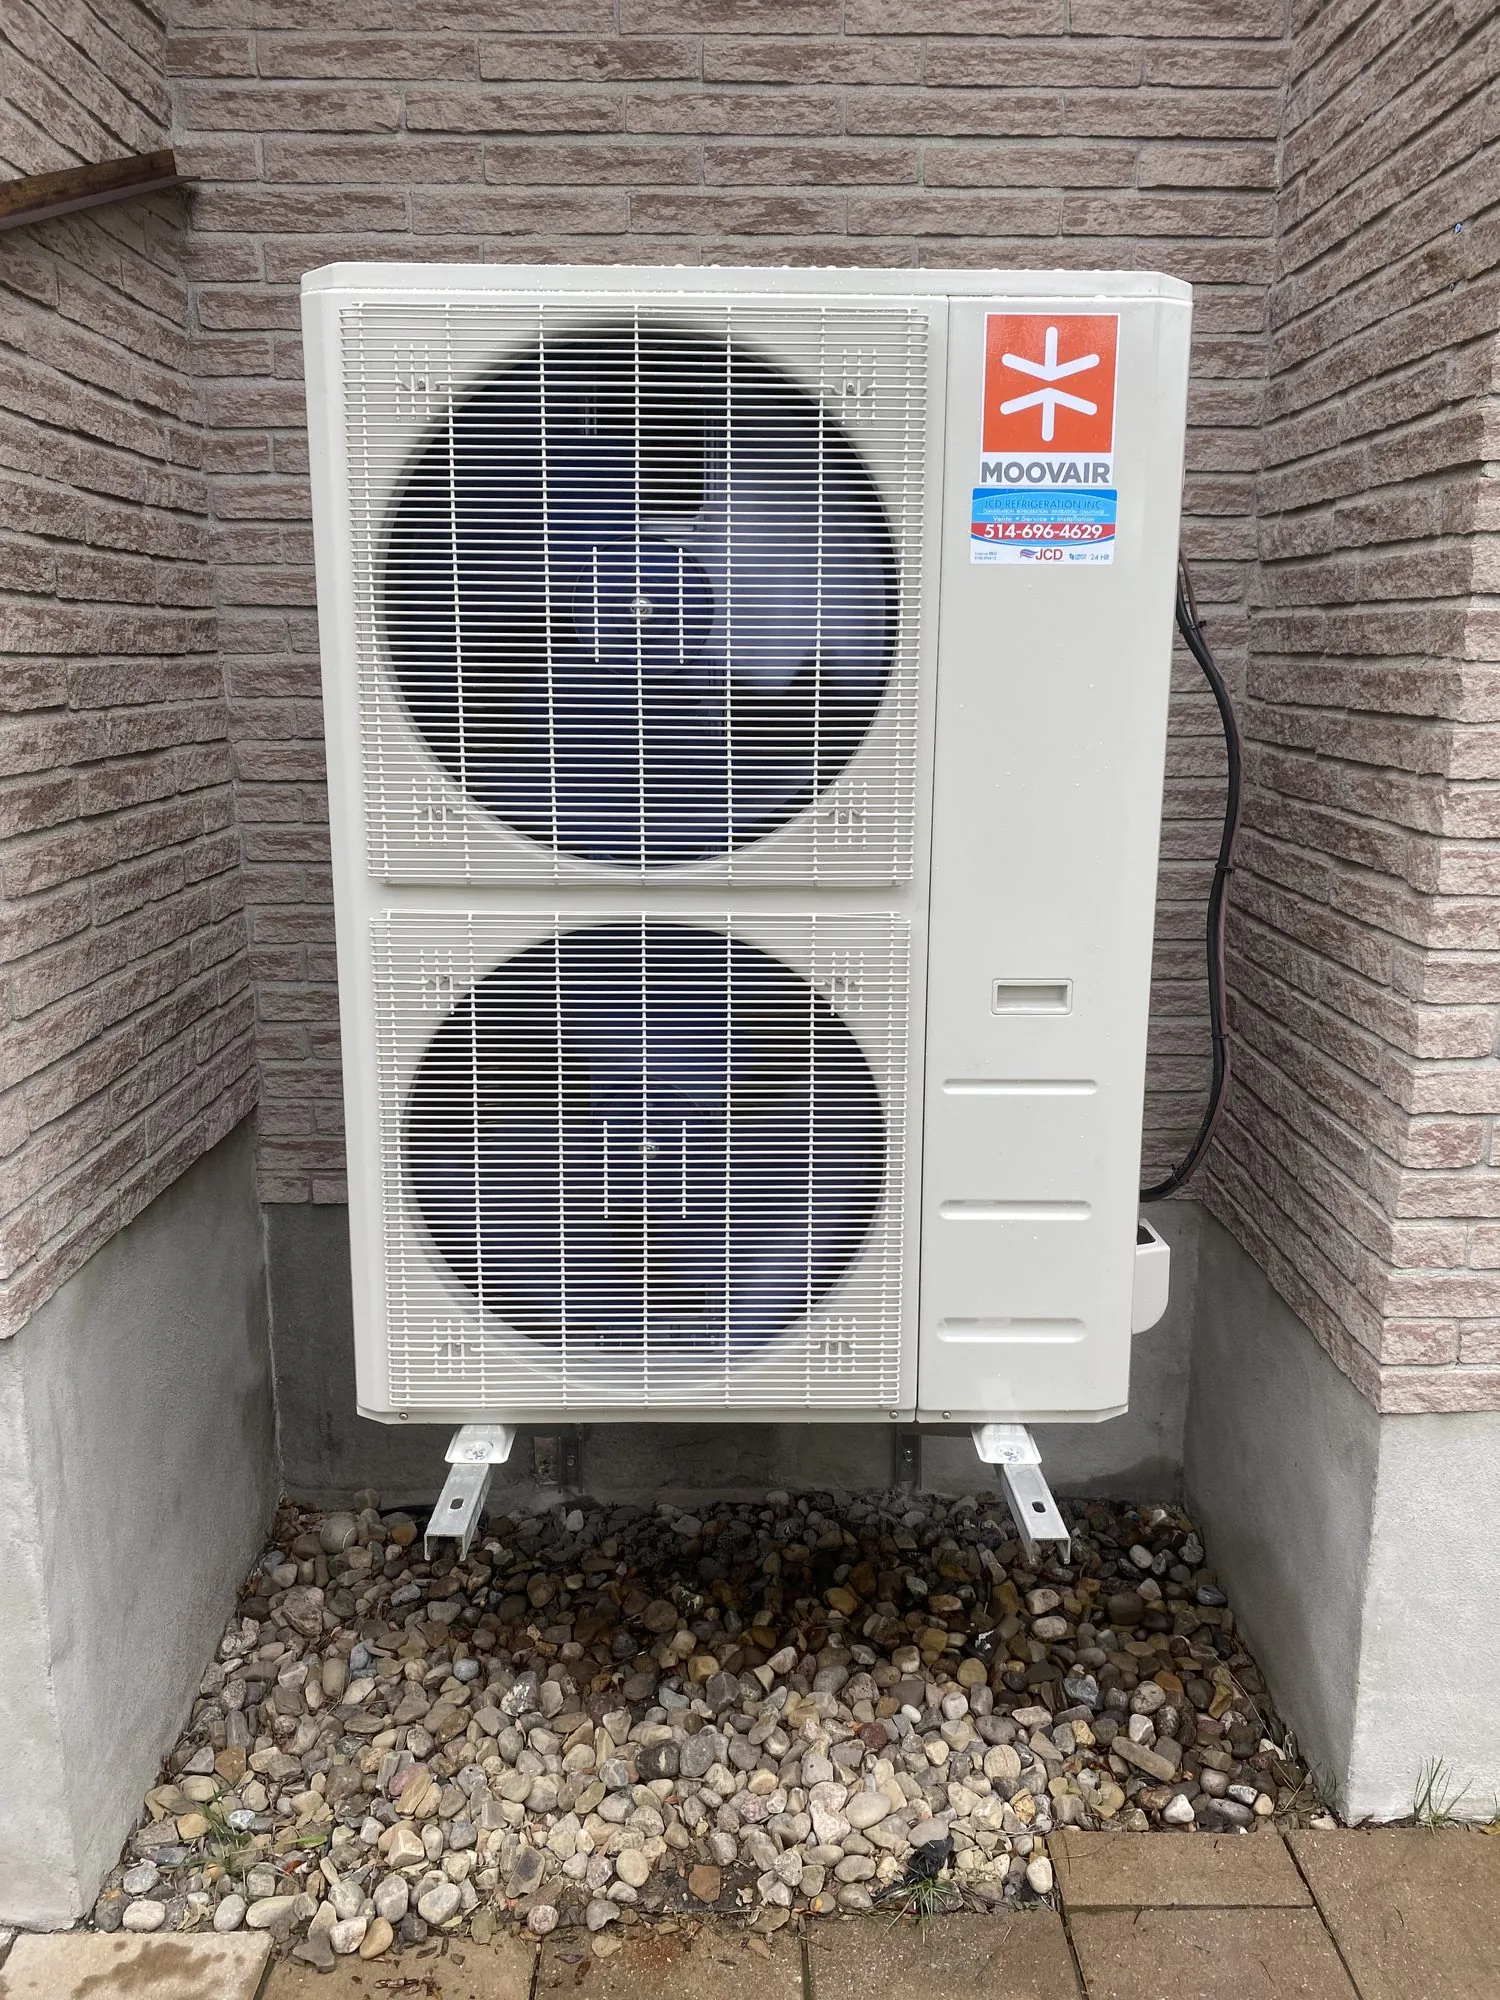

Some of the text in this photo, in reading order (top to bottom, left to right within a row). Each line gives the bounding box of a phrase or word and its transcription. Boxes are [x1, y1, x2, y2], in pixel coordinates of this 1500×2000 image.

[981, 461, 1110, 484] MOOVAIR
[984, 500, 1001, 509] JCD
[1005, 500, 1080, 509] REFRIGERATION
[984, 524, 1103, 539] 514-696-4629
[1035, 549, 1063, 561] JCD
[1090, 553, 1099, 561] 24
